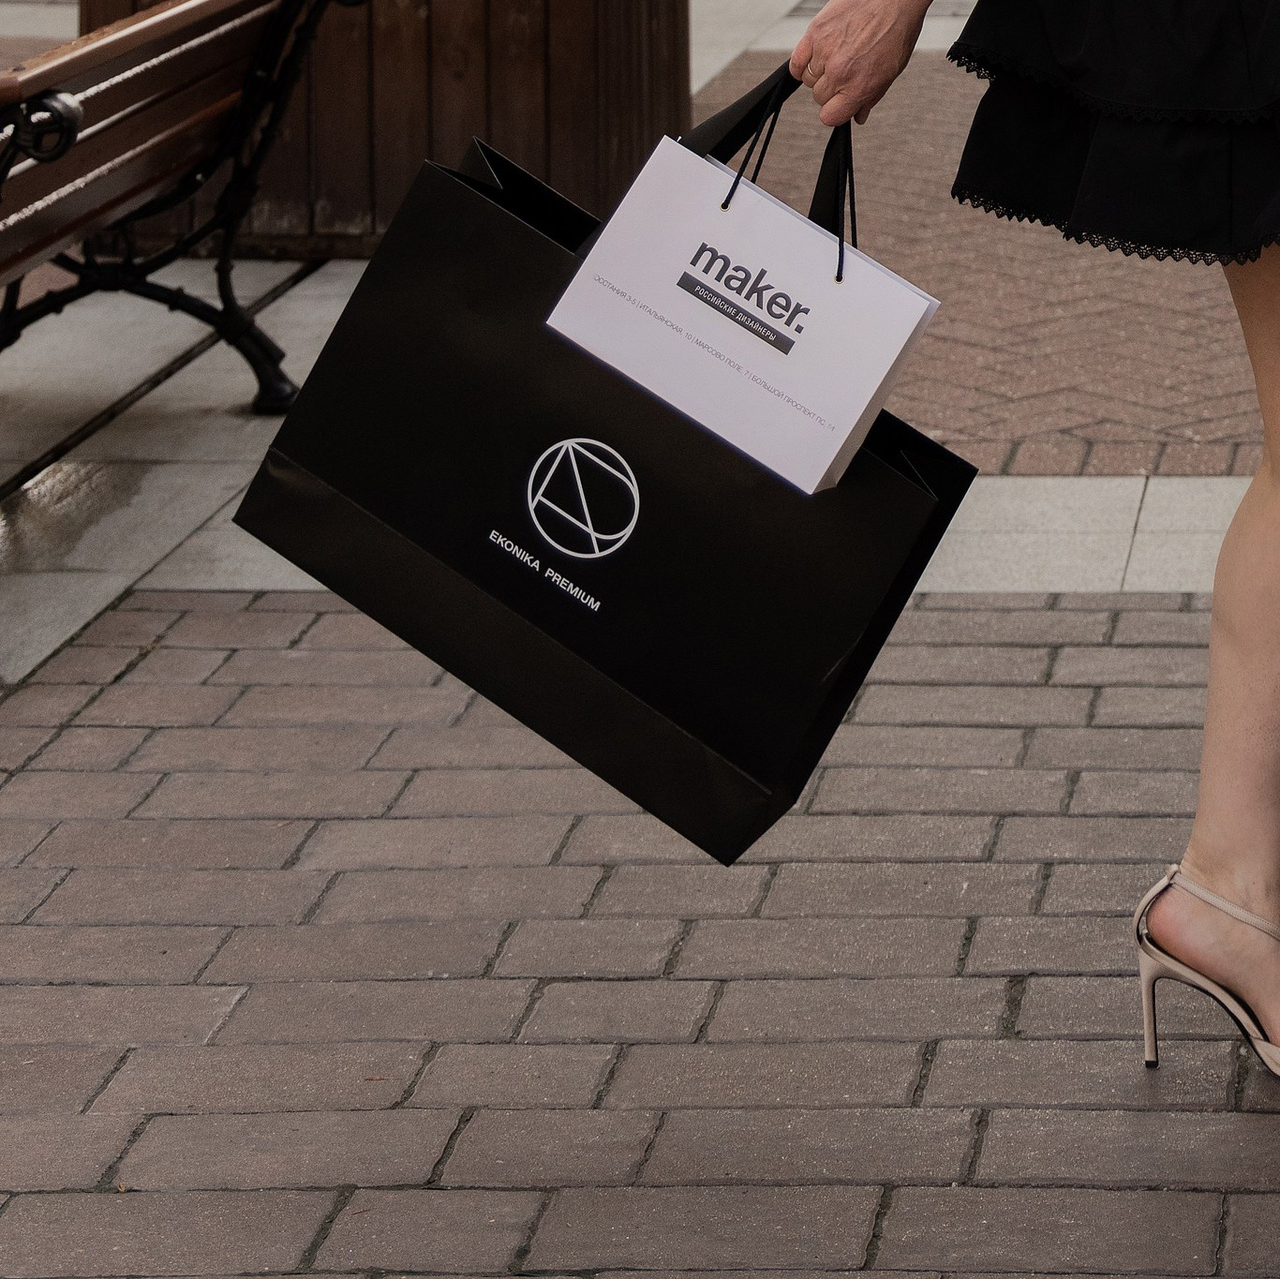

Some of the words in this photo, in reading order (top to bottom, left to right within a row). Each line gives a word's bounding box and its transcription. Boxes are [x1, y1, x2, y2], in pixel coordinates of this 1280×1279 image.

[689, 241, 811, 334] maker.
[694, 285, 736, 315] РОССИЙСКИЕ
[735, 312, 776, 340] ДИЗАЙНЕРЫ
[684, 332, 692, 340] 10
[693, 338, 725, 361] МАРСОВО
[750, 374, 784, 398] БОЛЬШОЙ
[782, 394, 816, 418] ПРОСПЕКТ
[489, 530, 540, 572] EKONIKA
[544, 567, 601, 612] PREMIUM
